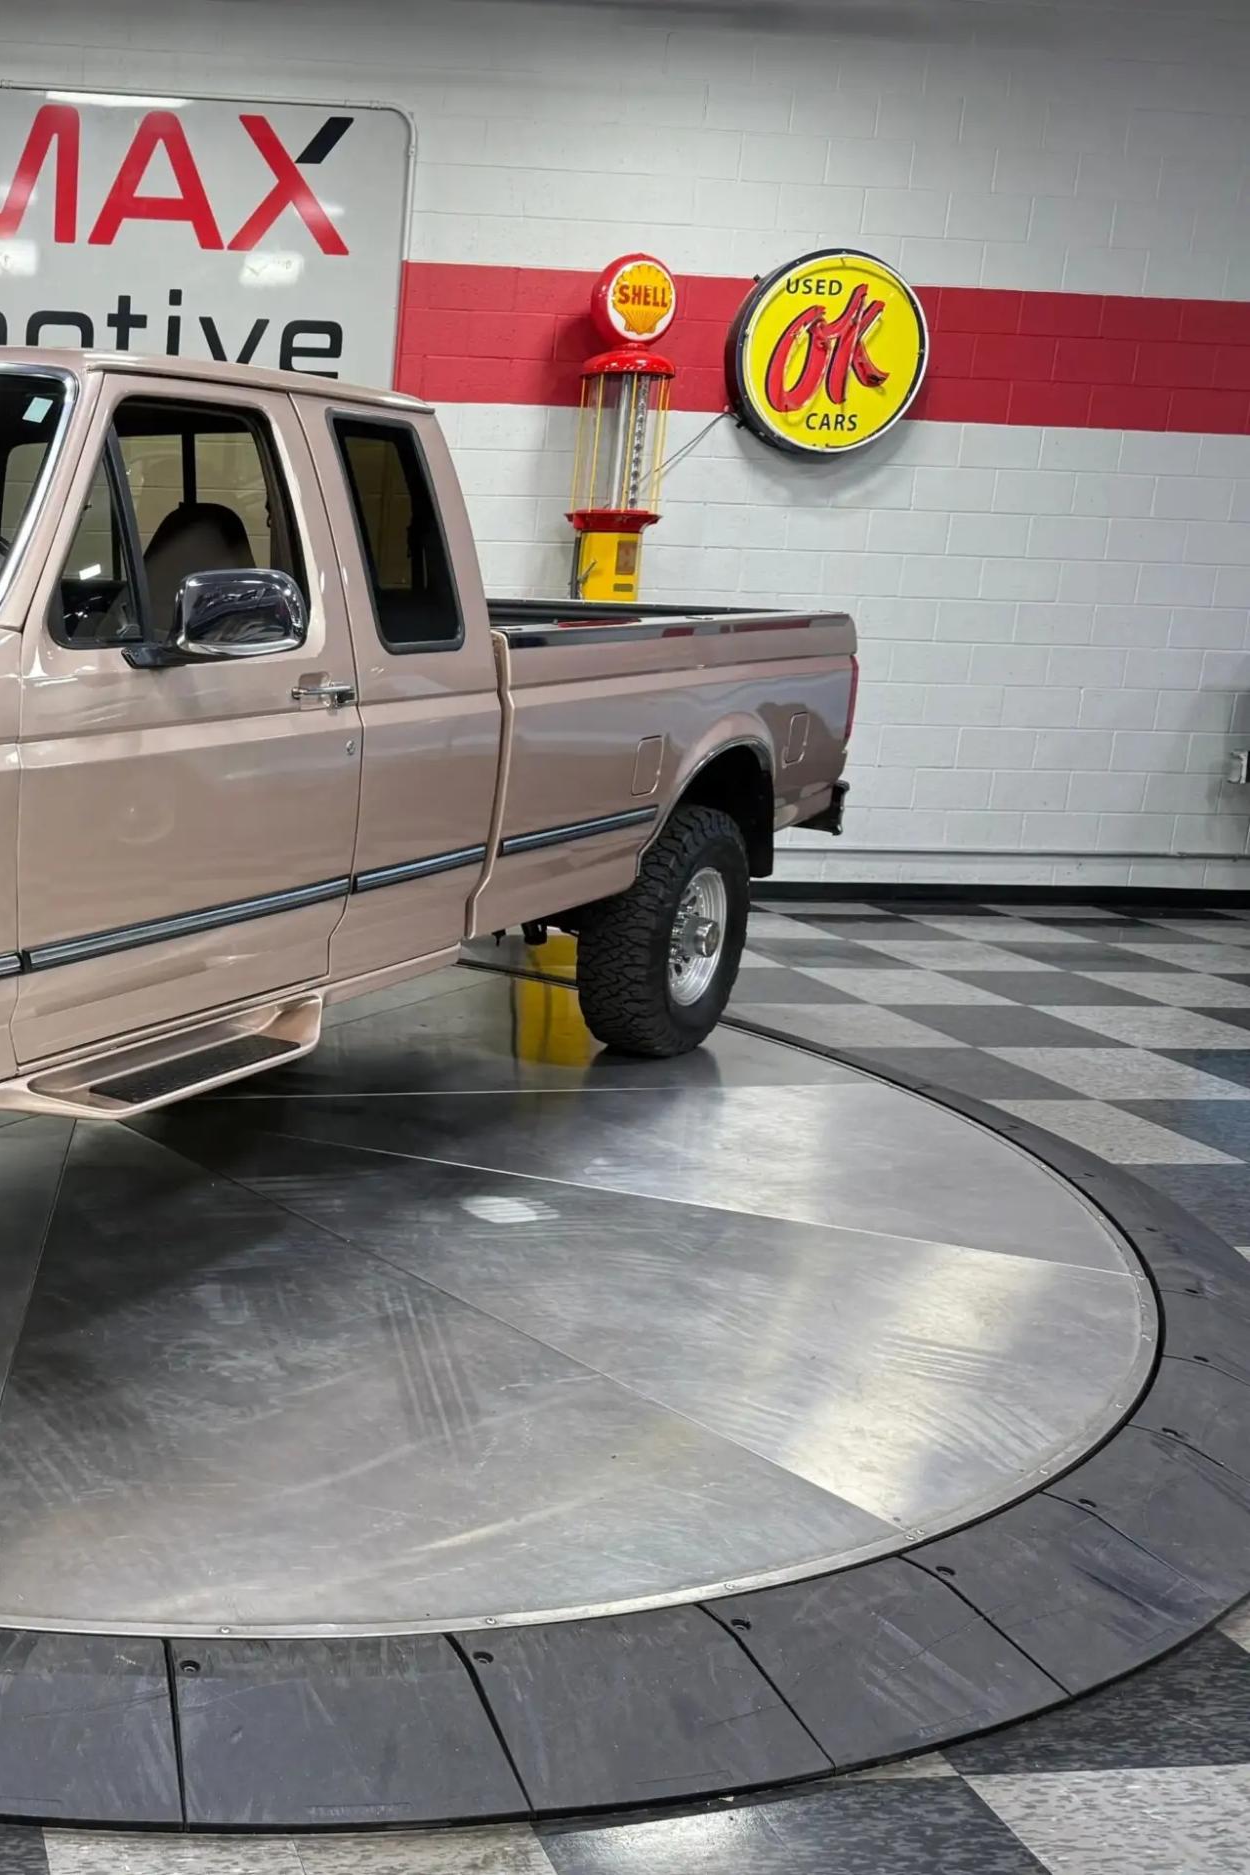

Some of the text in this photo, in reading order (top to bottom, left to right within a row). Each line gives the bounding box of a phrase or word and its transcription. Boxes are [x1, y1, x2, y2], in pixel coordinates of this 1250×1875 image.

[617, 283, 669, 308] SHELL
[786, 278, 843, 296] USED
[764, 283, 891, 413] OK
[805, 412, 858, 431] CARS
